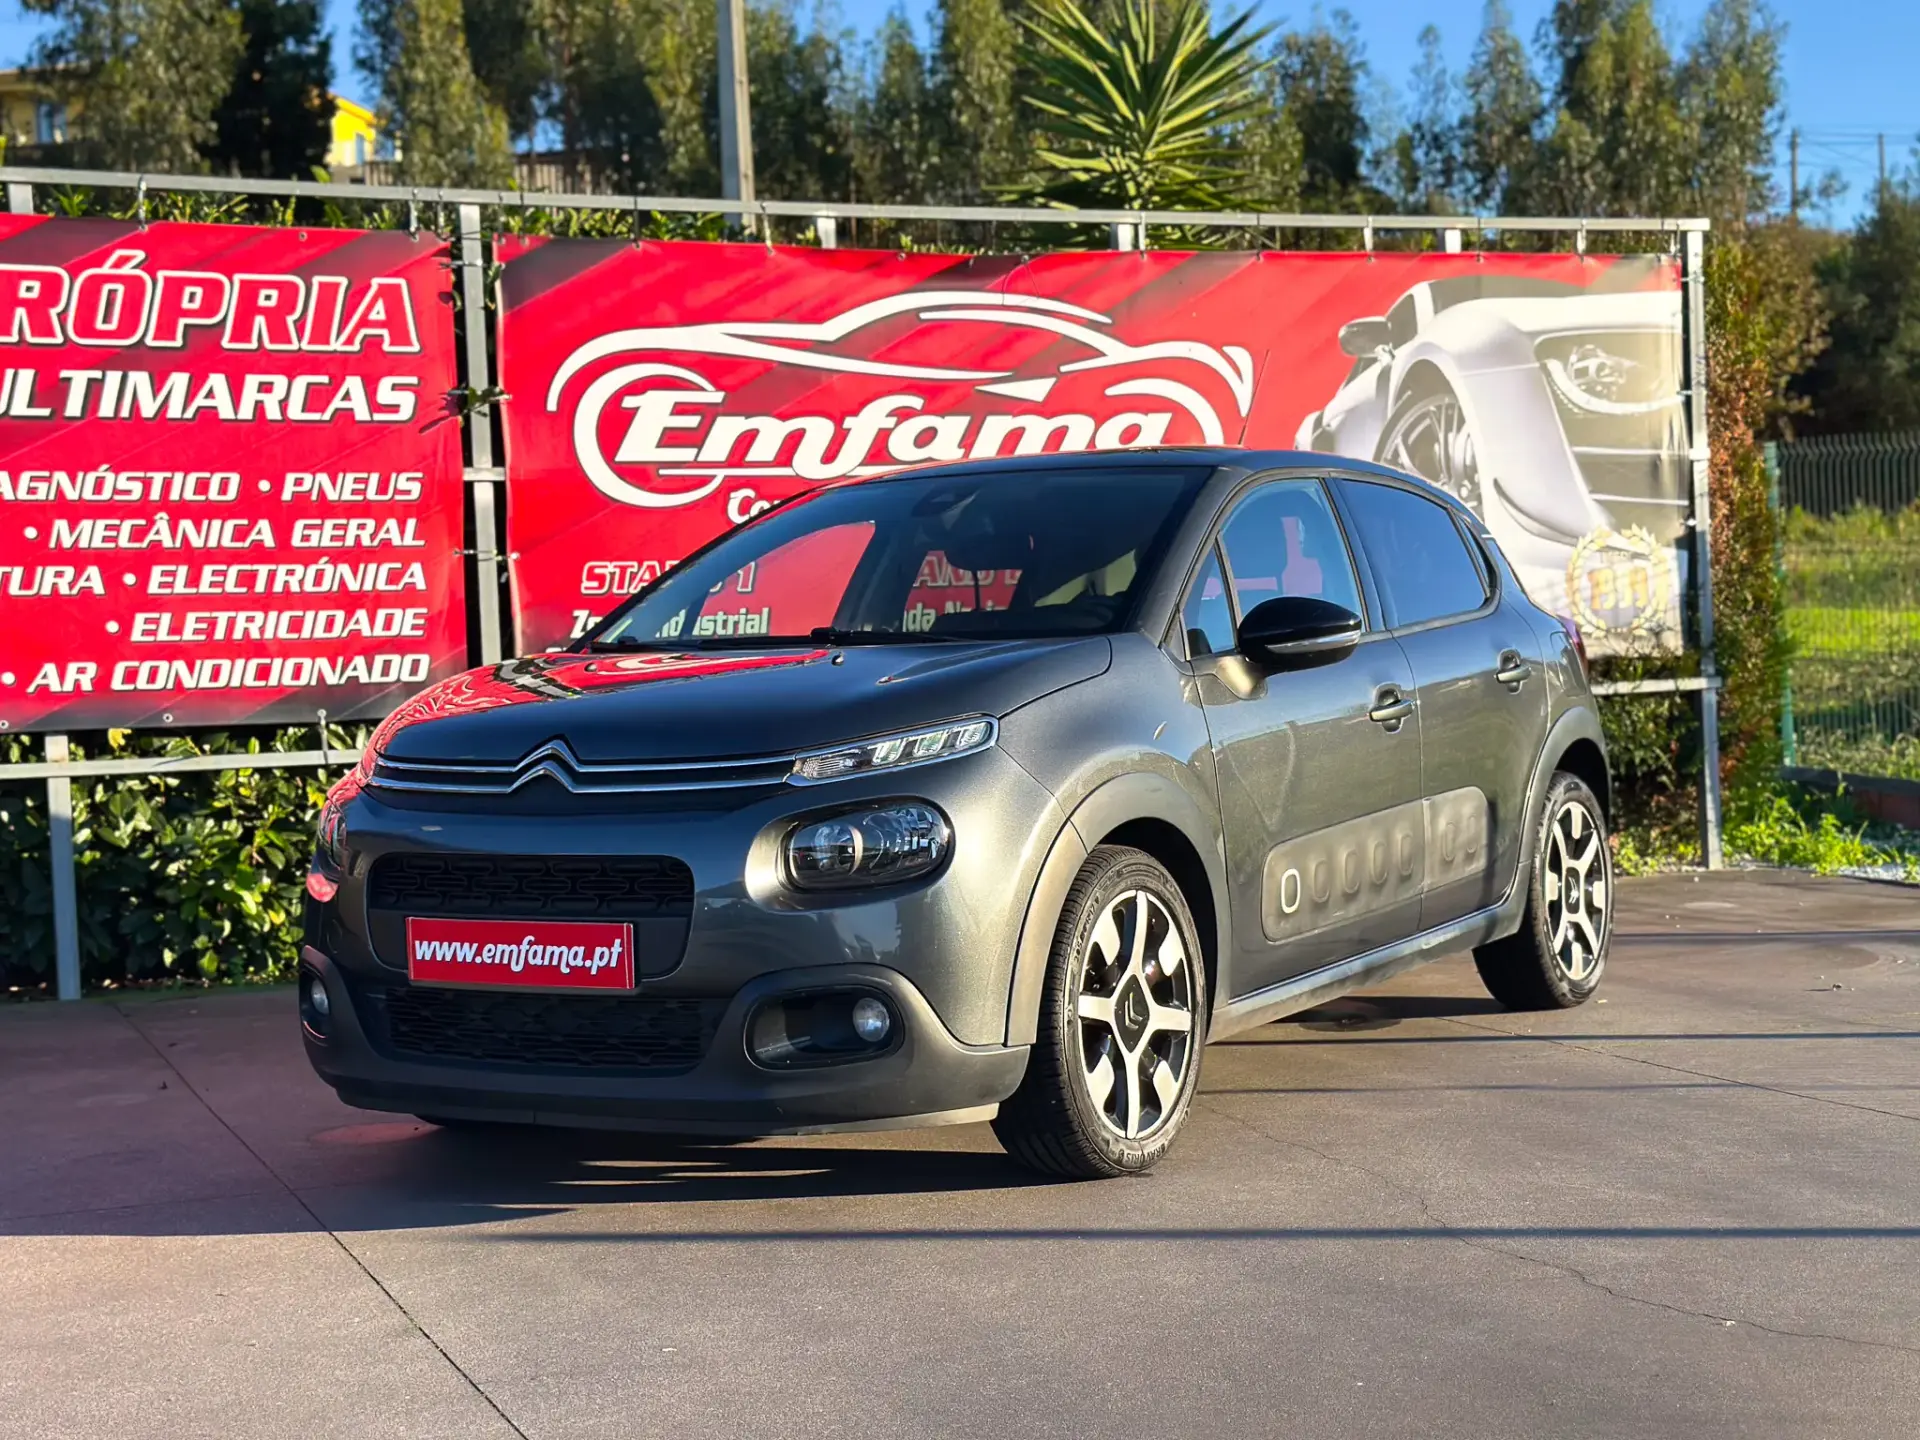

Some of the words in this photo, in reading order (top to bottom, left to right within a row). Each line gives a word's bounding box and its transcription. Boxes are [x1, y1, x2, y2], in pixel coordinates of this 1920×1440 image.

[614, 390, 1173, 480] Emfama
[281, 471, 424, 502] PNEUS
[49, 512, 276, 549] MECÂNICA
[291, 518, 426, 548] GERAL
[147, 556, 427, 595] ELECTRÓNICA
[130, 608, 428, 643] ELETRICIDADE
[26, 662, 98, 694] AR
[111, 654, 430, 692] CONDICIONADO
[414, 935, 622, 975] www.emfama.pt
